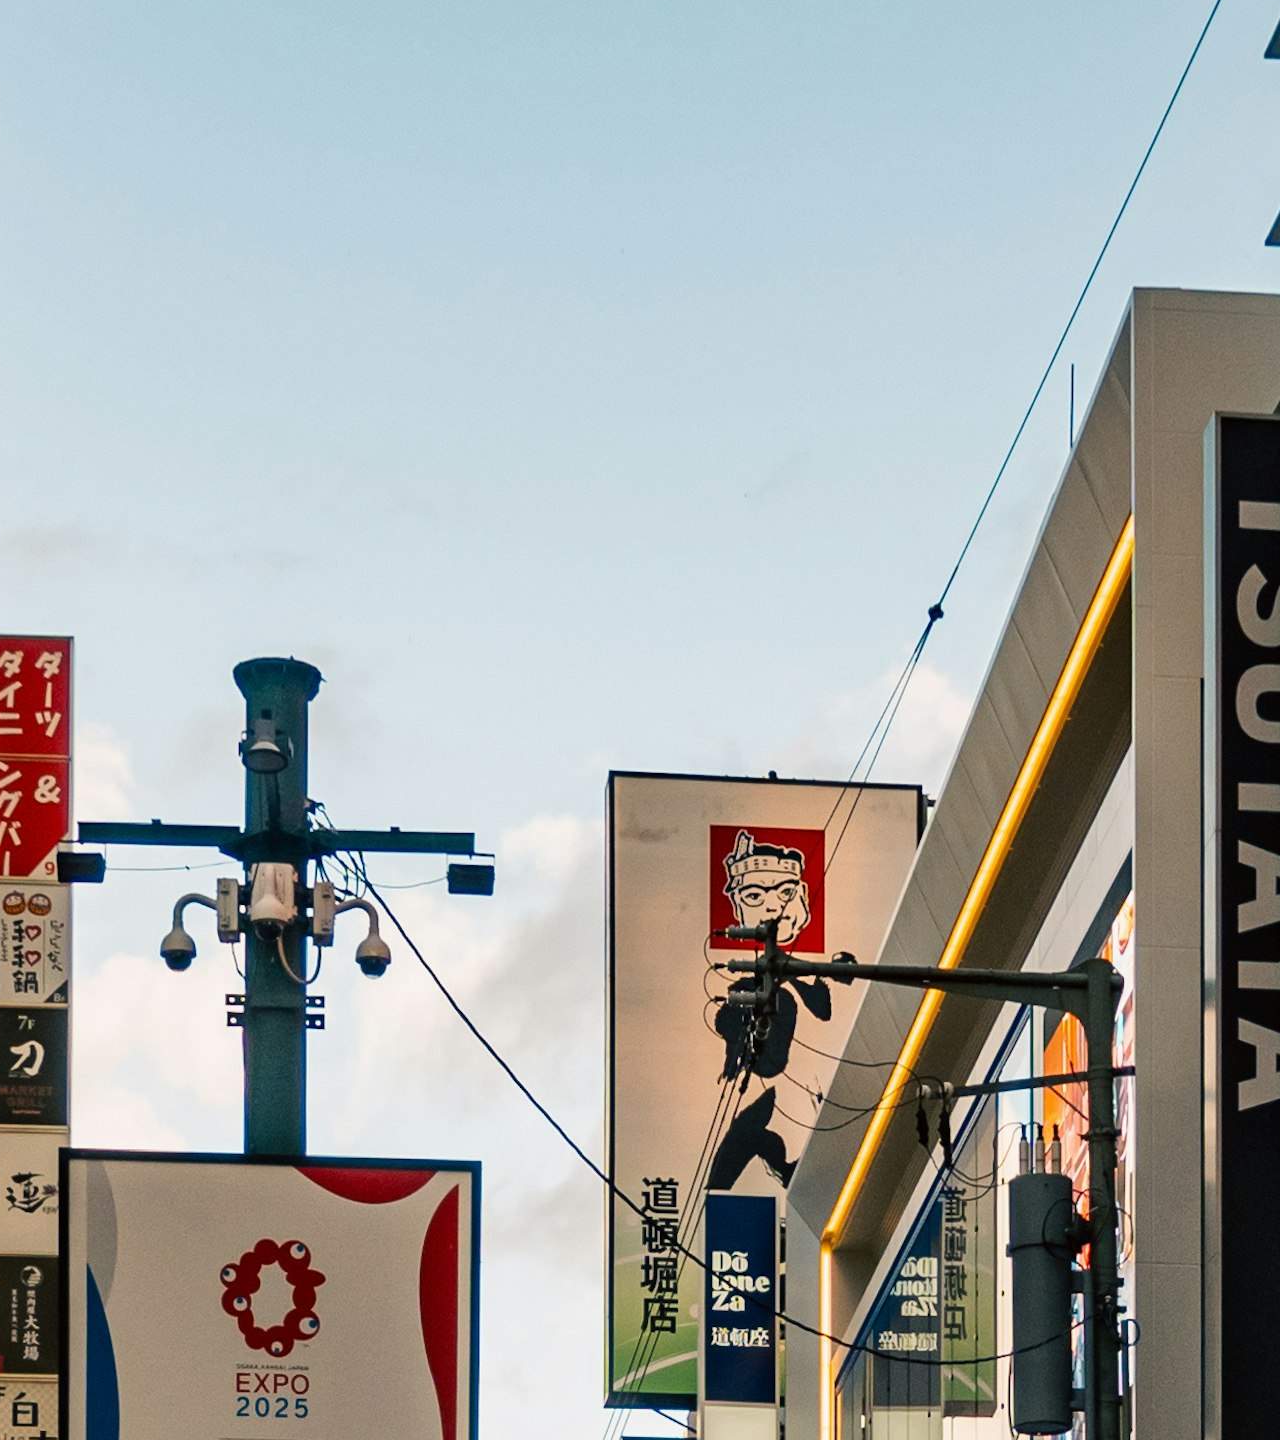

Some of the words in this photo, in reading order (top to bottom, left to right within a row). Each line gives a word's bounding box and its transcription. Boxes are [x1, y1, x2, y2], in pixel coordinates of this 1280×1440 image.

[18, 1015, 36, 1030] 7F
[10, 1039, 45, 1077] 刀
[640, 1176, 679, 1334] 道頓堀店
[710, 1326, 770, 1348] 道頓座
[236, 1372, 310, 1395] EXPO
[236, 1395, 309, 1419] 2025
